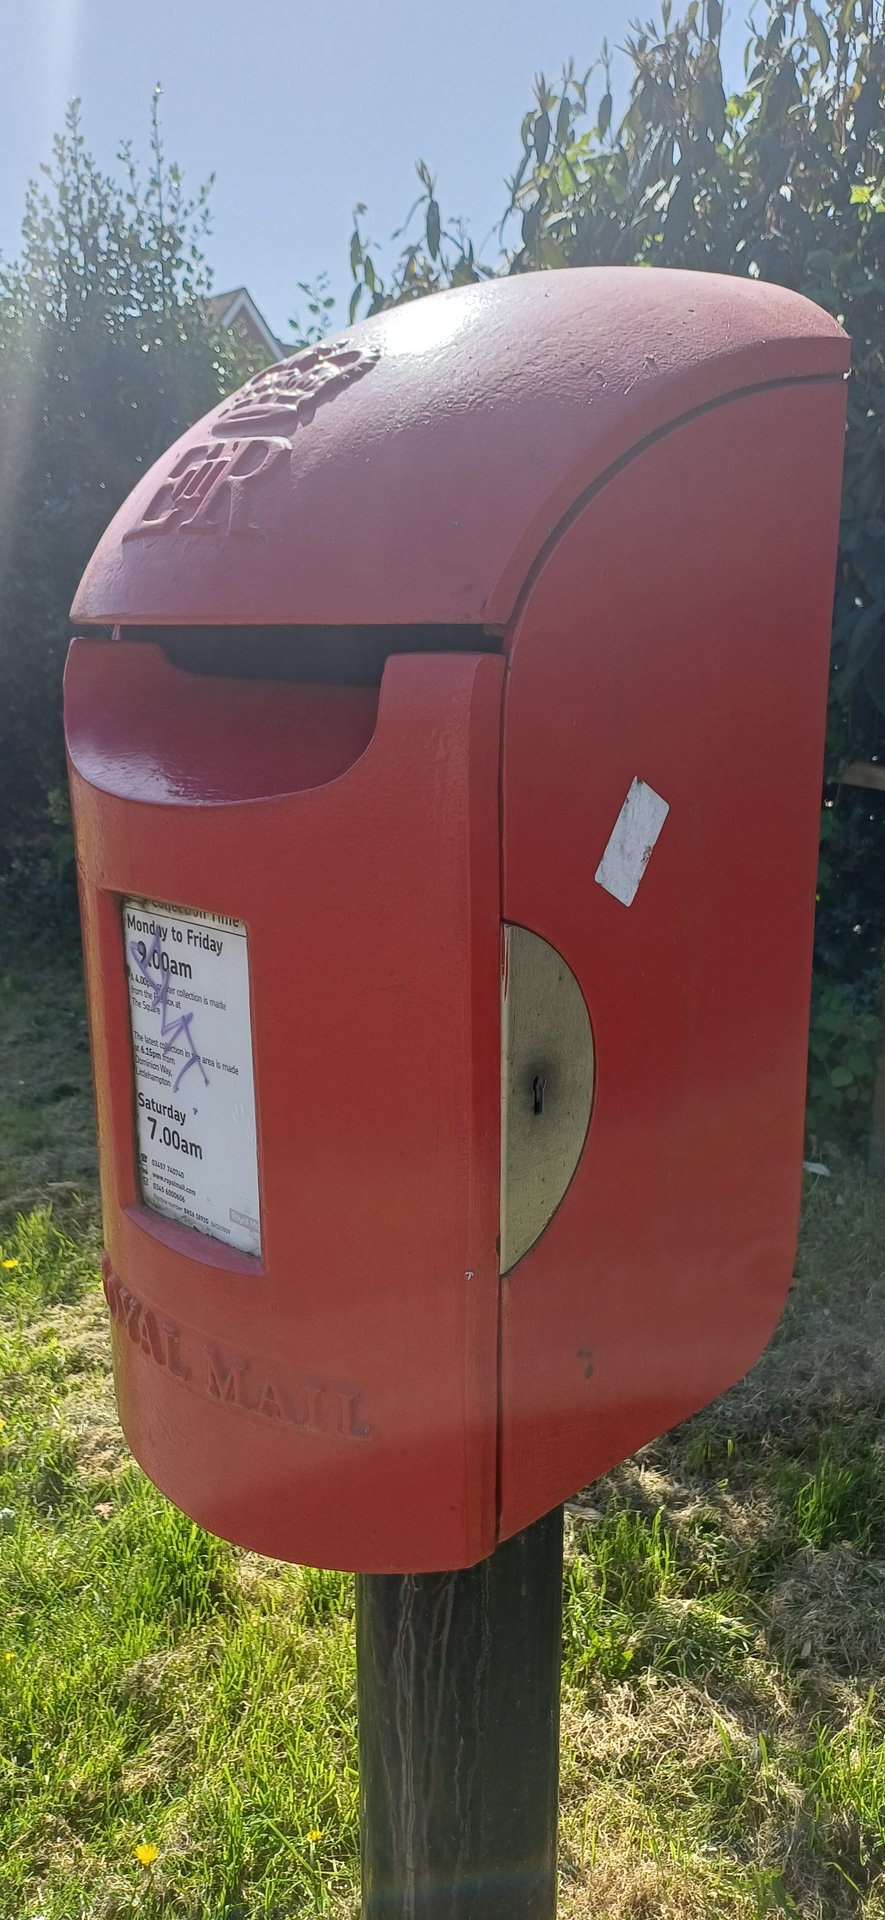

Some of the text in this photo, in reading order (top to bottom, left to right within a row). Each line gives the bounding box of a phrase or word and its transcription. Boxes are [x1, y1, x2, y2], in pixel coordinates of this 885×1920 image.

[171, 926, 183, 943] to
[187, 930, 223, 956] Friday
[137, 941, 192, 979] 9.00am
[131, 985, 143, 996] from
[144, 990, 152, 1000] the
[132, 997, 161, 1014] The Square
[136, 975, 155, 989] 4.00p
[177, 988, 202, 1003] collection
[204, 996, 208, 1005] is
[210, 999, 226, 1010] made
[134, 1031, 144, 1042] The
[145, 1035, 158, 1048] latest
[185, 1049, 190, 1058] in
[202, 1057, 215, 1067] area
[216, 1060, 221, 1069] is
[222, 1064, 239, 1075] made
[135, 1055, 159, 1071] Dominion
[141, 1046, 161, 1060] 6.15pm
[162, 1053, 176, 1065] from
[135, 1066, 171, 1087] Littlehampton
[138, 1092, 186, 1126] Saturday
[147, 1116, 203, 1160] 7.00am
[152, 1159, 166, 1171] 03457
[152, 1172, 196, 1196] www.royalmail.com
[102, 1252, 378, 1443] OYAL MAIL
